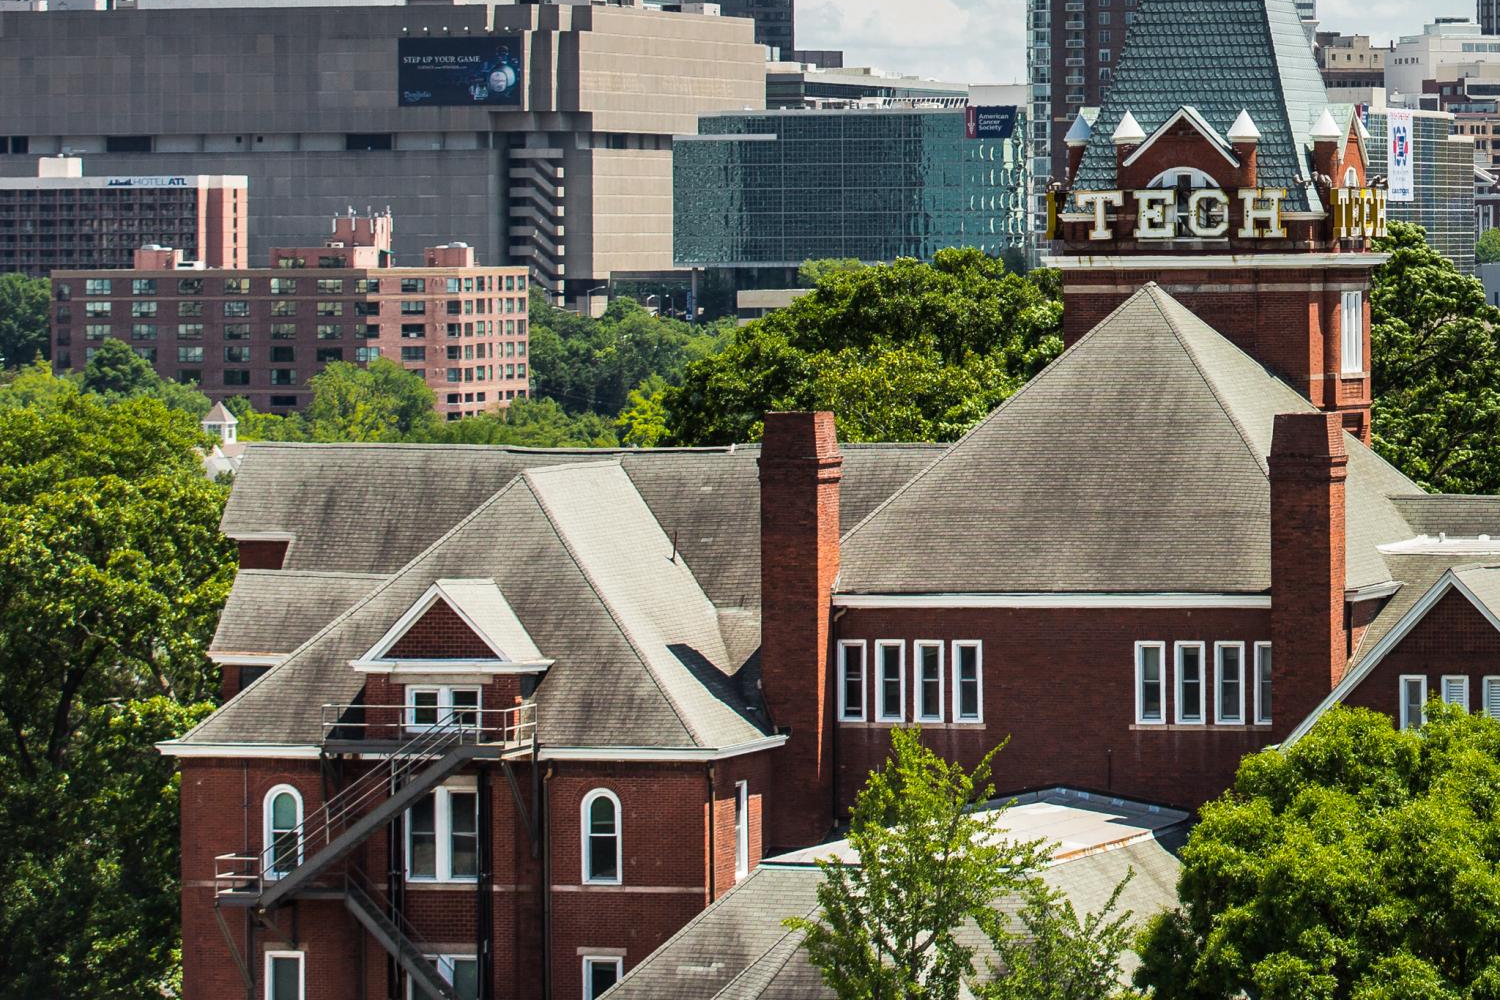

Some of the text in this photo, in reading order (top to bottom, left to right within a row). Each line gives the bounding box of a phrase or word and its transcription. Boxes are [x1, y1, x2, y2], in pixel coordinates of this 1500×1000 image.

[403, 55, 421, 64] STEP
[422, 55, 433, 63] UP
[434, 55, 456, 63] YOUR
[134, 177, 187, 186] HOTEL ATL
[1076, 188, 1288, 241] TECH
[1330, 188, 1388, 238] TECH
